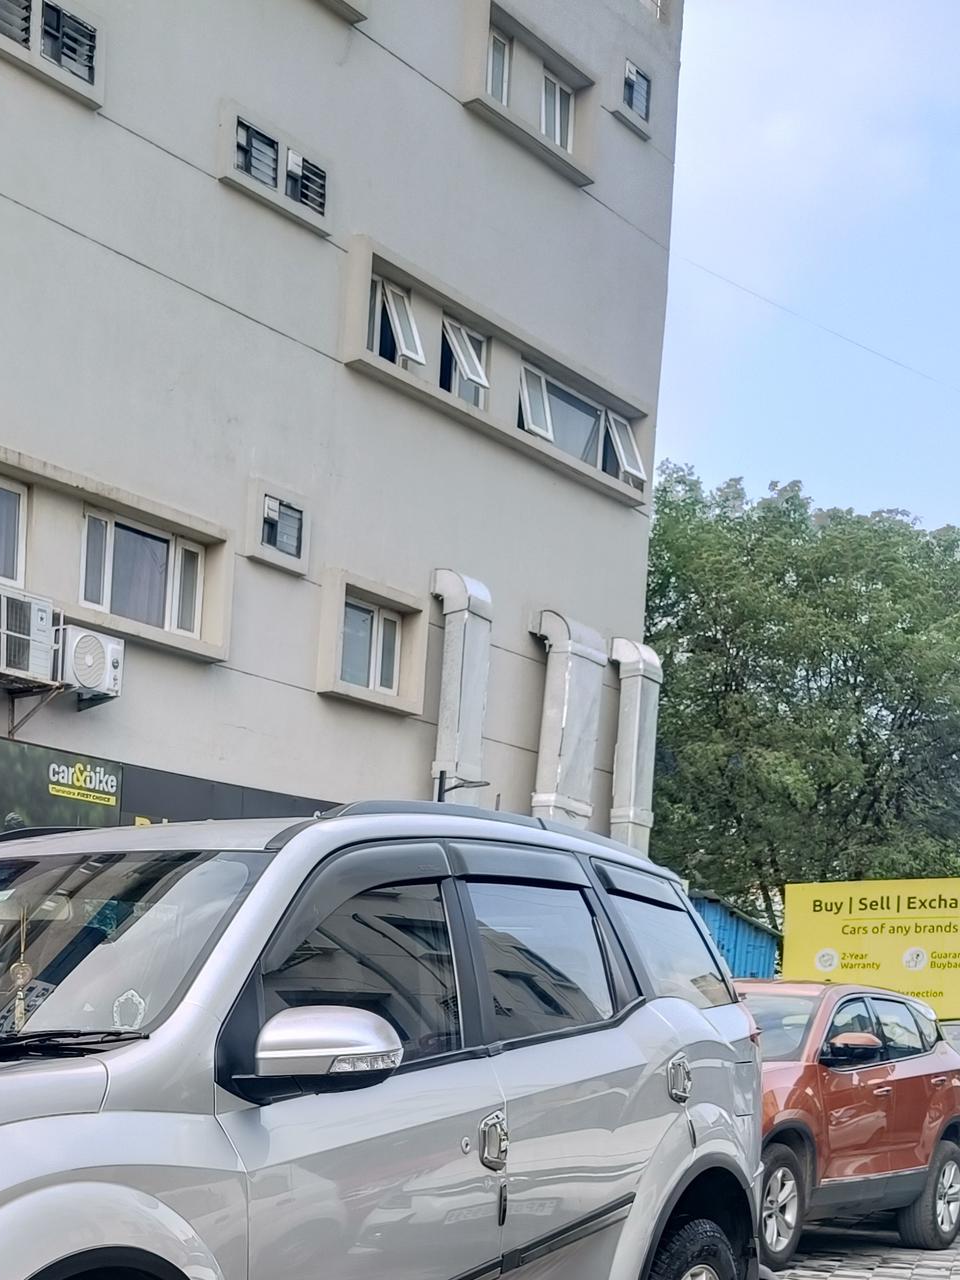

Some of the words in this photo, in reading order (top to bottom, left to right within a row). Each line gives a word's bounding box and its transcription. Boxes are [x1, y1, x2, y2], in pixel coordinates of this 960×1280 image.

[48, 763, 117, 793] car&bike
[812, 899, 844, 915] Buy
[858, 896, 891, 911] Sell
[841, 924, 868, 936] Cars
[871, 923, 886, 935] of
[888, 925, 911, 936] any
[914, 922, 959, 934] brands
[841, 952, 868, 961] 2-Year
[840, 961, 881, 970] Warranty
